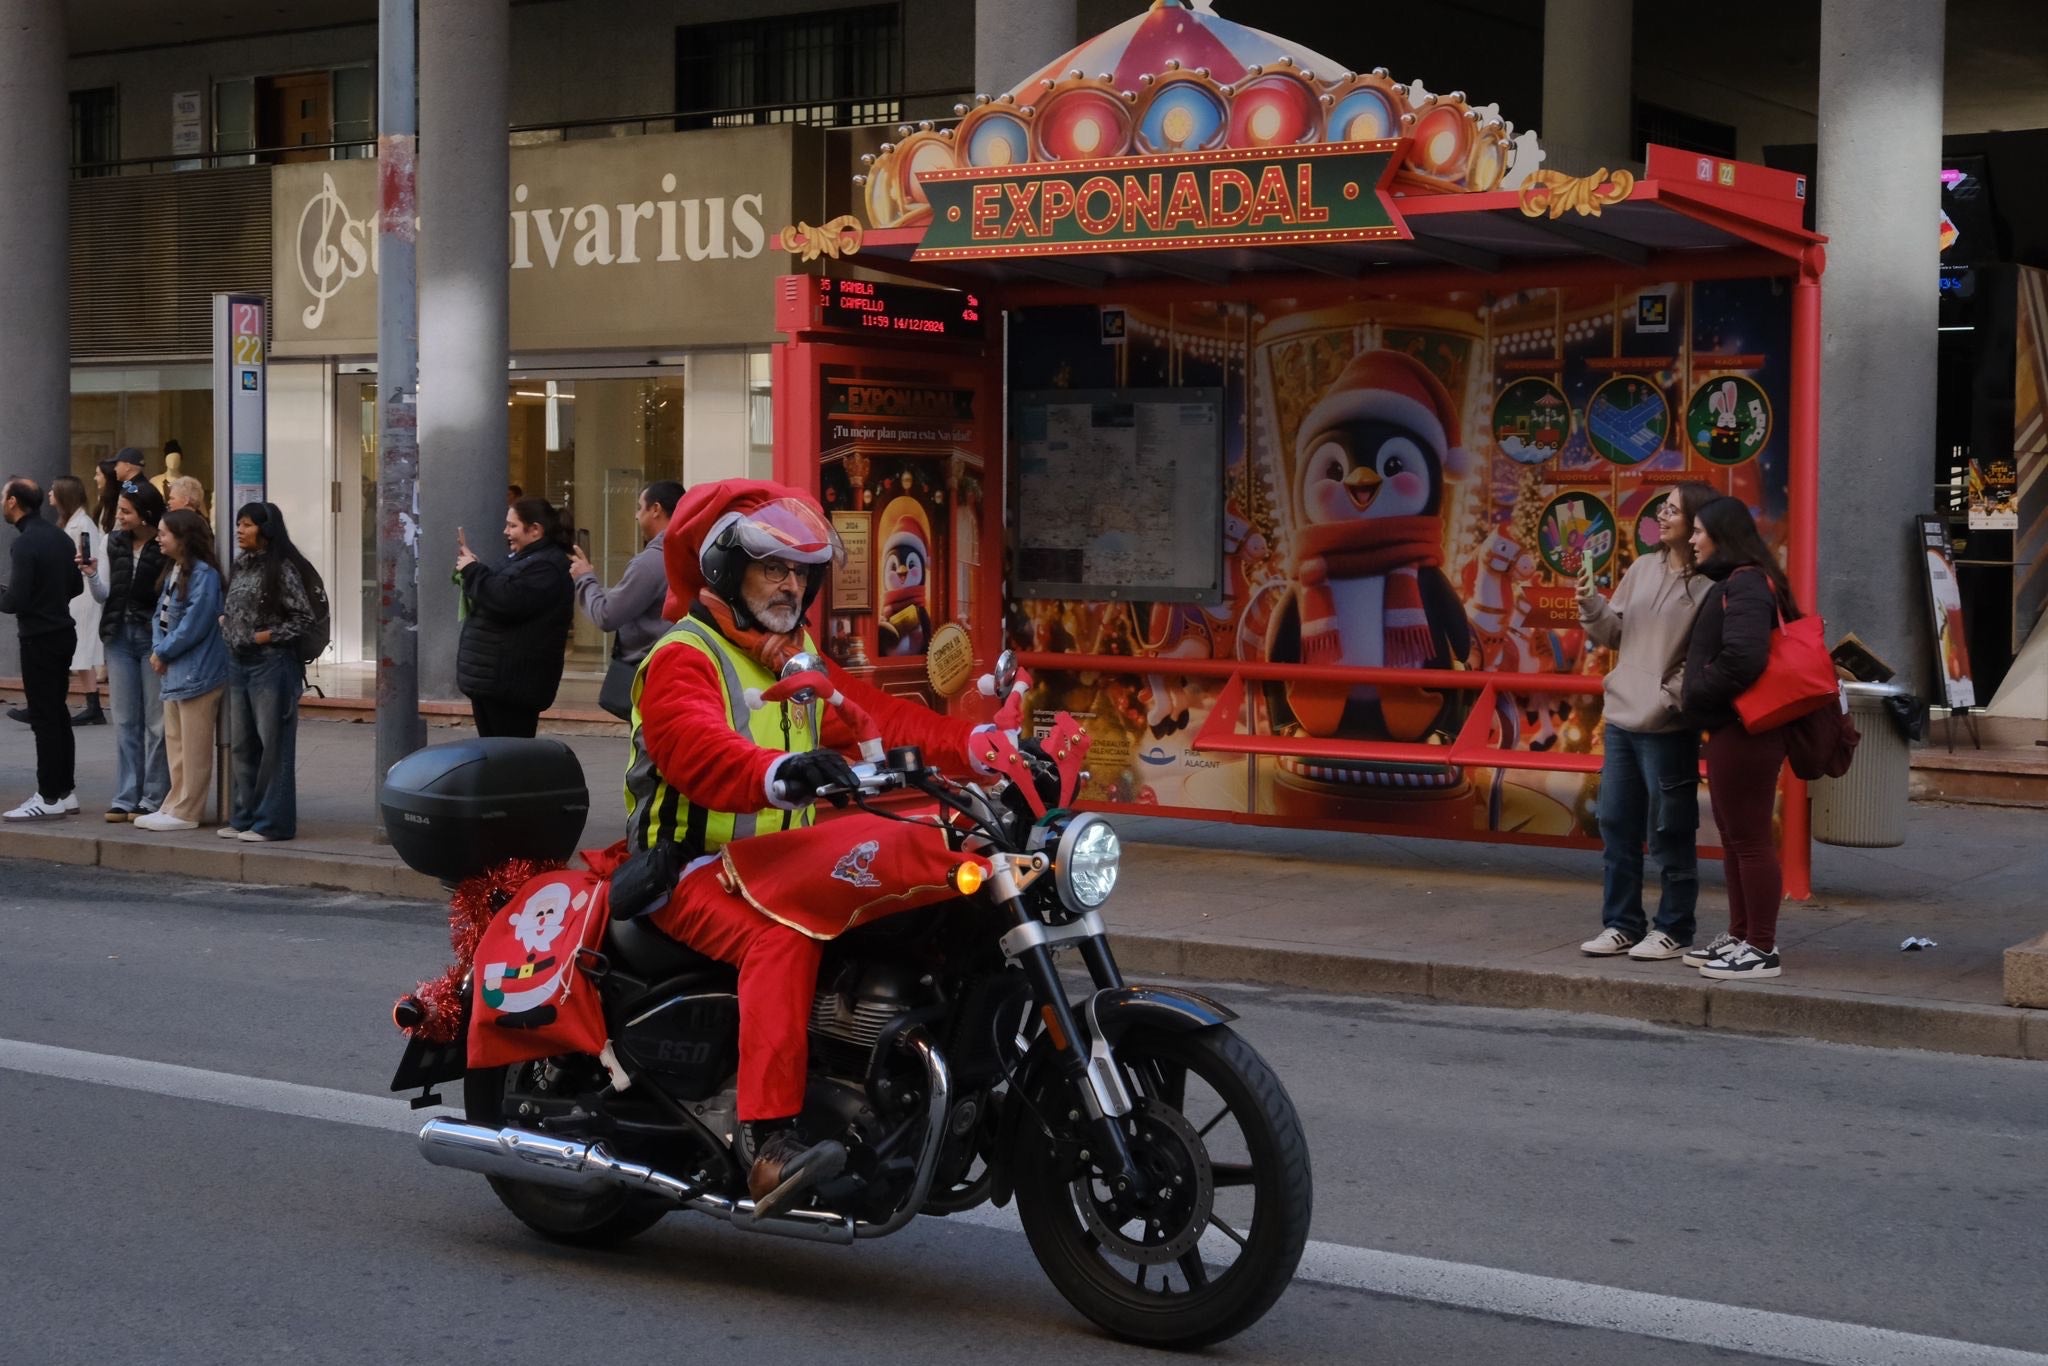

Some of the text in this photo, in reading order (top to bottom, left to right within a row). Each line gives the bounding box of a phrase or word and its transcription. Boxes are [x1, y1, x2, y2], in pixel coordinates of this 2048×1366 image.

[971, 163, 1329, 240] EXPONADAL
[342, 173, 766, 278] stivarius
[840, 281, 874, 295] RAMBLA
[820, 295, 830, 307] 21
[840, 297, 884, 312] CAMPELLO
[239, 304, 260, 335] 21
[862, 314, 945, 332] 11:59 14/12/2024
[236, 336, 262, 365] 22
[1713, 358, 1743, 367] MAGIA
[848, 386, 956, 417] EXPONADAL
[833, 425, 849, 440] ¡Tu
[850, 426, 876, 440] mejor
[877, 427, 896, 441] plan
[897, 430, 917, 441] para
[918, 430, 936, 441] esta
[1555, 473, 1600, 482] LUDOTECA
[1539, 596, 1577, 609] DICIE
[1549, 610, 1567, 619] Del
[1093, 739, 1130, 748] ENERALITAT
[1184, 760, 1220, 768] ALACANT
[657, 1040, 712, 1064] 650
